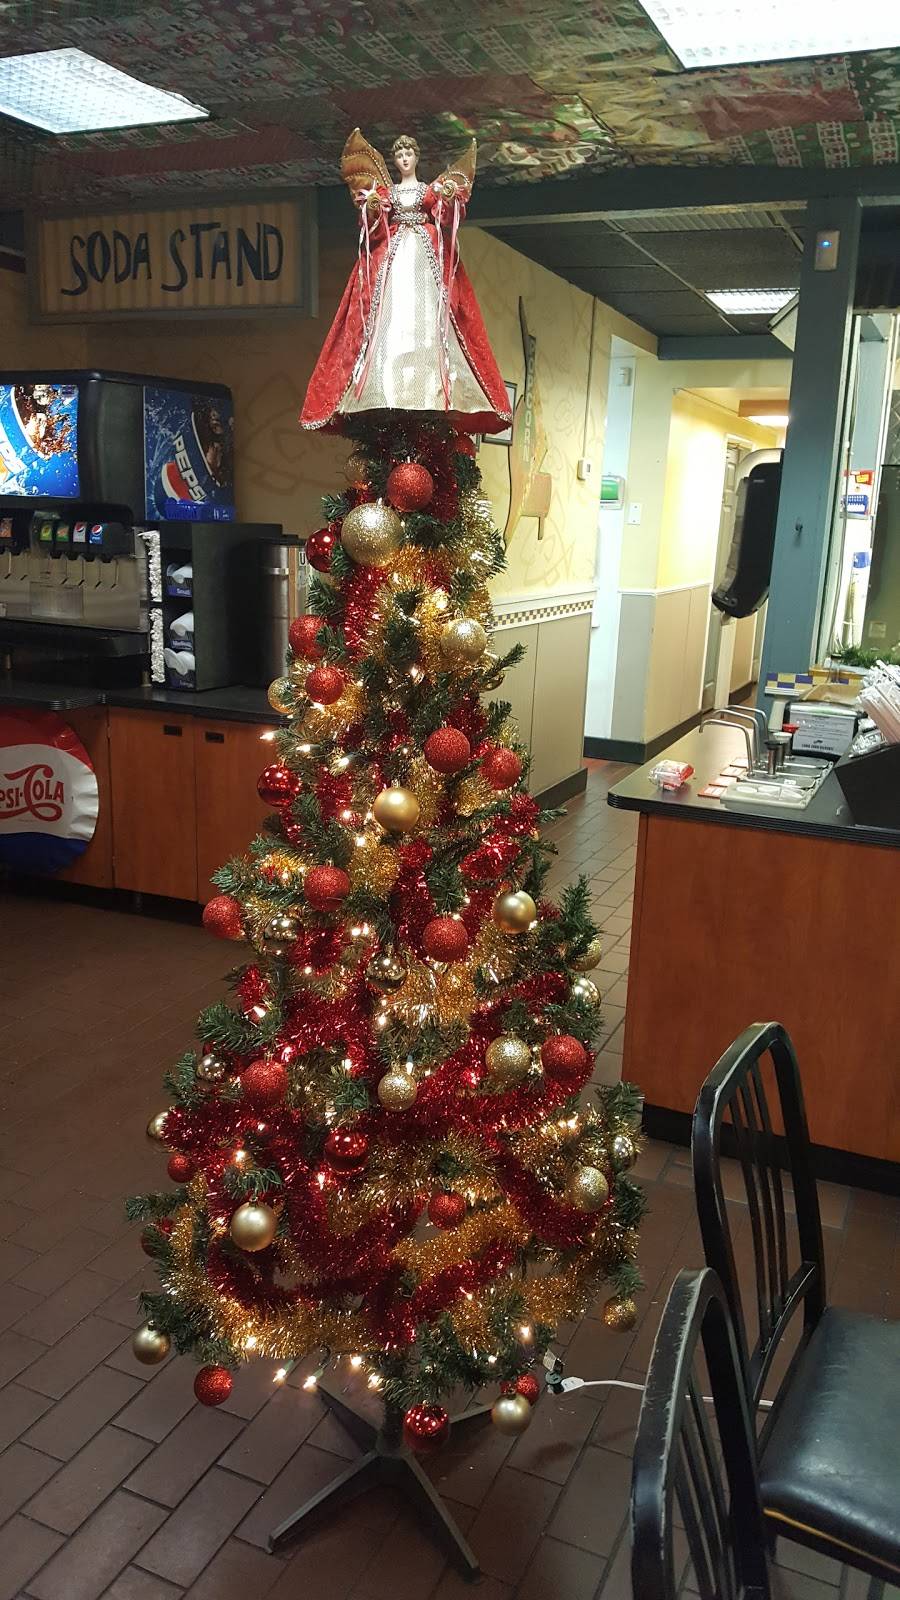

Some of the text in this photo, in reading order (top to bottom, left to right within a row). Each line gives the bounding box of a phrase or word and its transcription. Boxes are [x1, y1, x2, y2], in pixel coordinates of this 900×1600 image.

[60, 222, 284, 296] SODA STAND
[172, 433, 207, 504] PEPS
